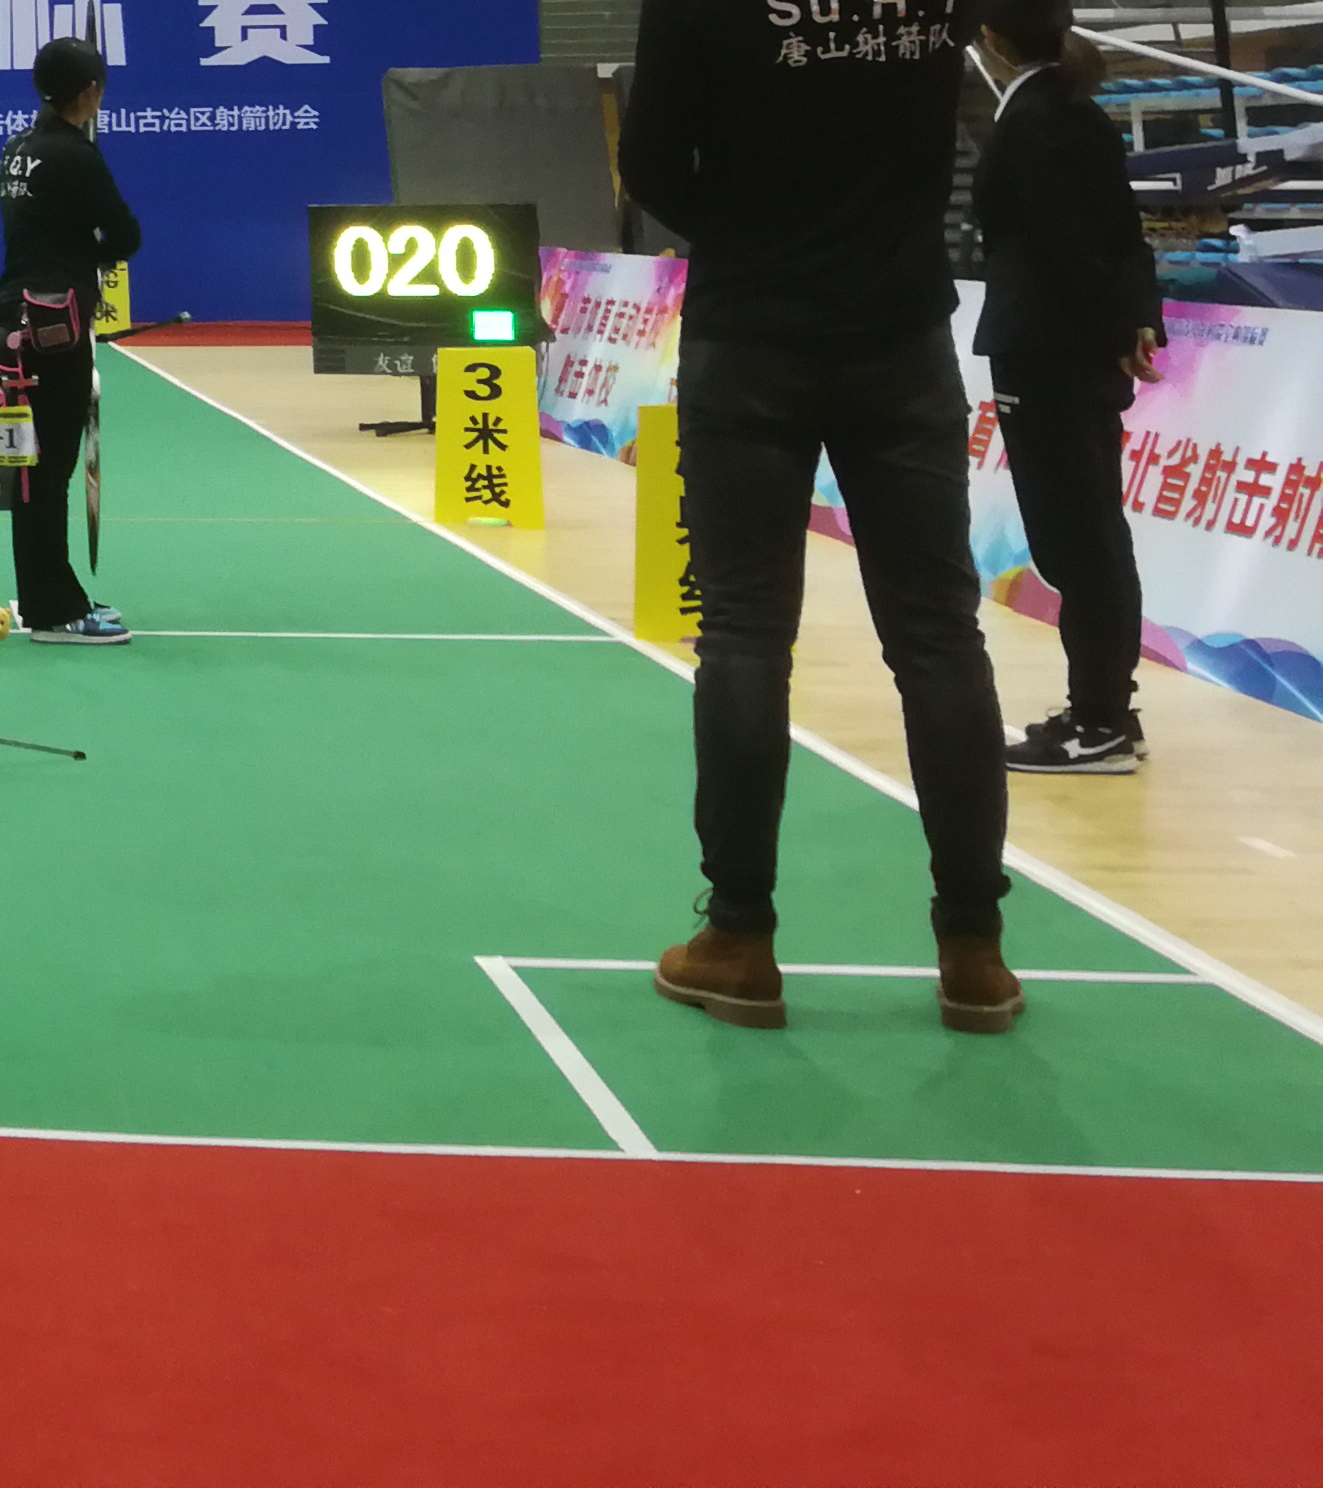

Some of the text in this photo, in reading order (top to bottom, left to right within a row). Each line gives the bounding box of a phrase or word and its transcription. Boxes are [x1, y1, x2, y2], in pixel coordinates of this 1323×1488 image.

[775, 22, 956, 69] 唐山射箭队
[333, 223, 495, 298] 020
[373, 352, 415, 374] 友谊
[462, 362, 511, 509] 3米线
